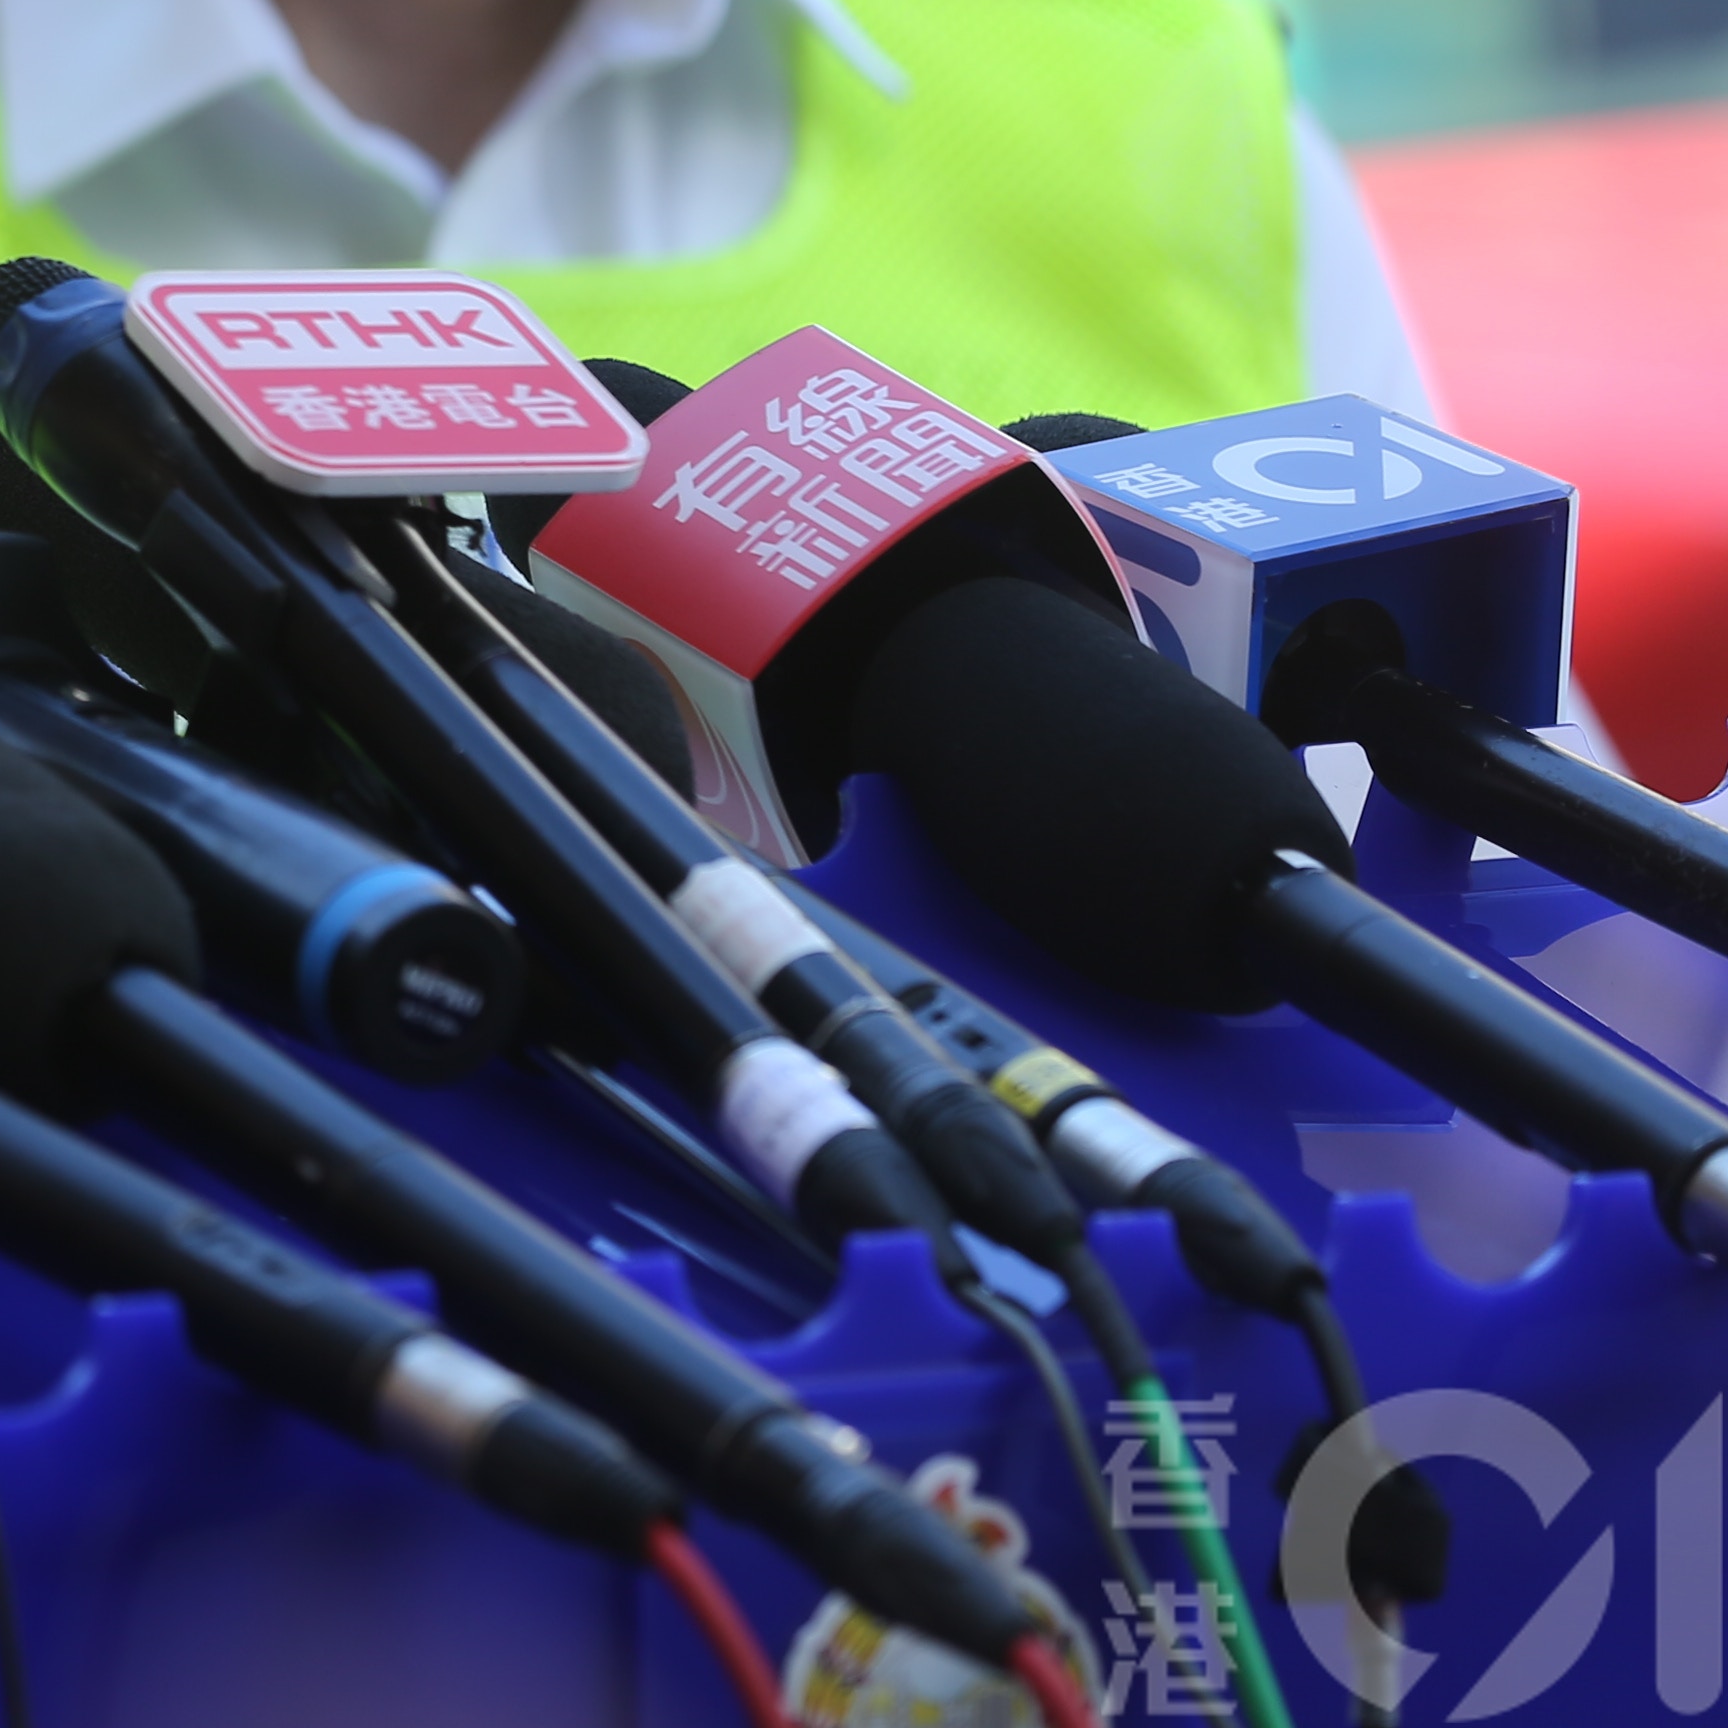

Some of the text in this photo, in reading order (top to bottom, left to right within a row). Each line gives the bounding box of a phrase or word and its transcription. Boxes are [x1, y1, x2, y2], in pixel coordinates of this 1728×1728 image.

[195, 309, 516, 350] RTHK
[261, 383, 590, 432] 香港電台
[652, 368, 920, 532] 有線
[737, 408, 1009, 591] 新聞
[1092, 462, 1280, 533] 香港
